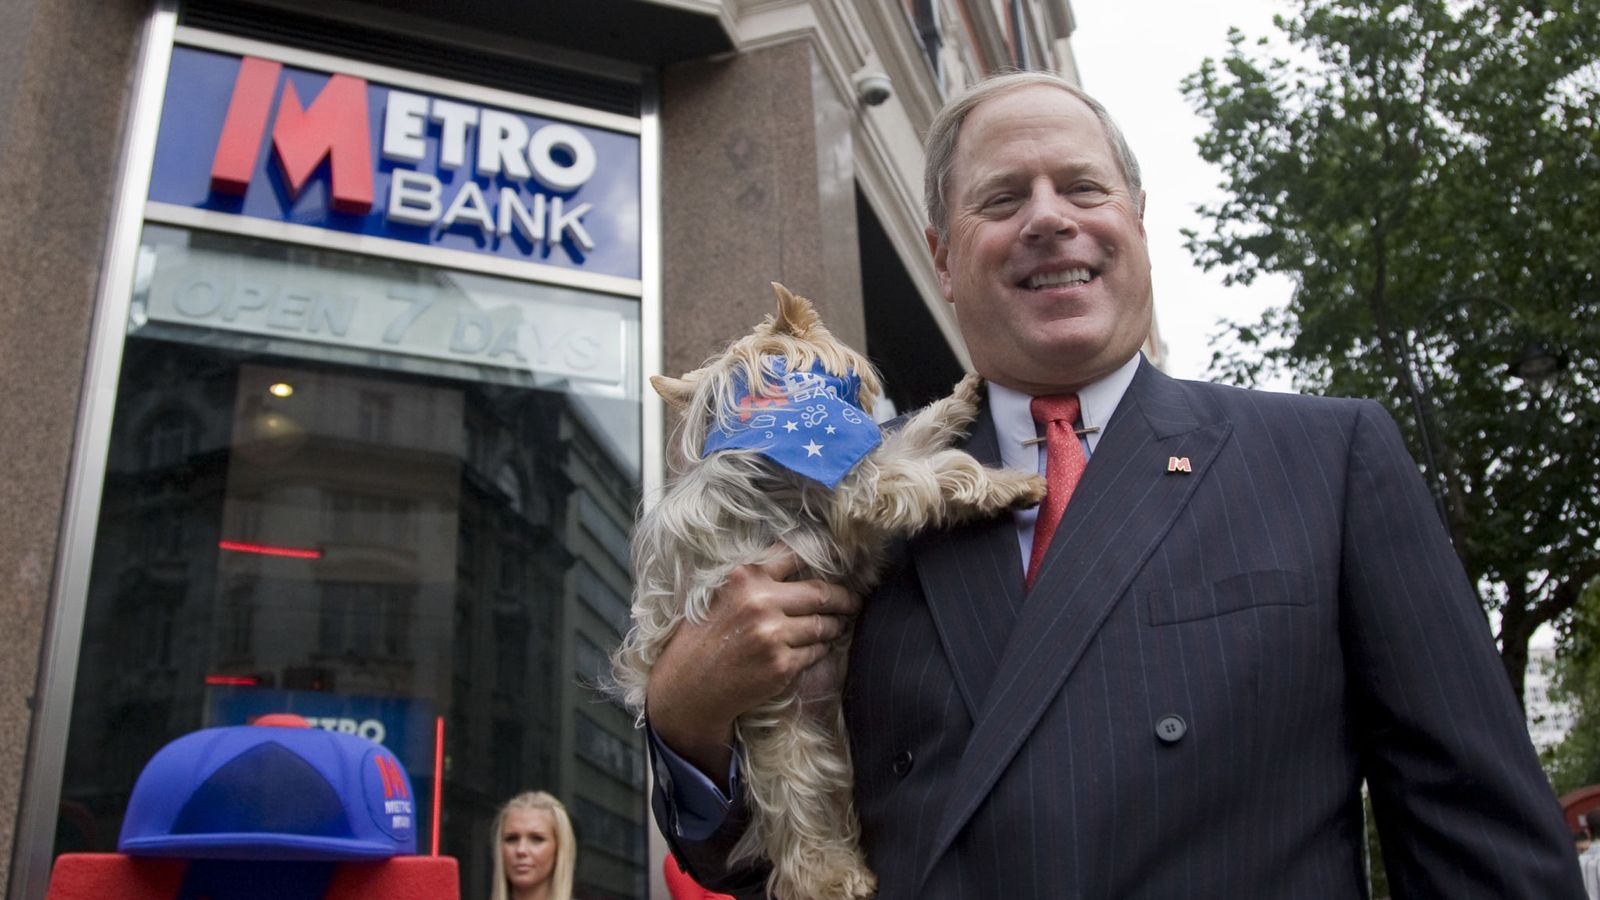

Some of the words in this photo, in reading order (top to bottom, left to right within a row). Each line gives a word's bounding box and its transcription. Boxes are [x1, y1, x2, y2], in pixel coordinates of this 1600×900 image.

[210, 56, 597, 215] METRO
[387, 168, 594, 252] BANK
[172, 278, 361, 339] OPEN
[383, 285, 436, 345] 7
[449, 305, 602, 371] DAYS
